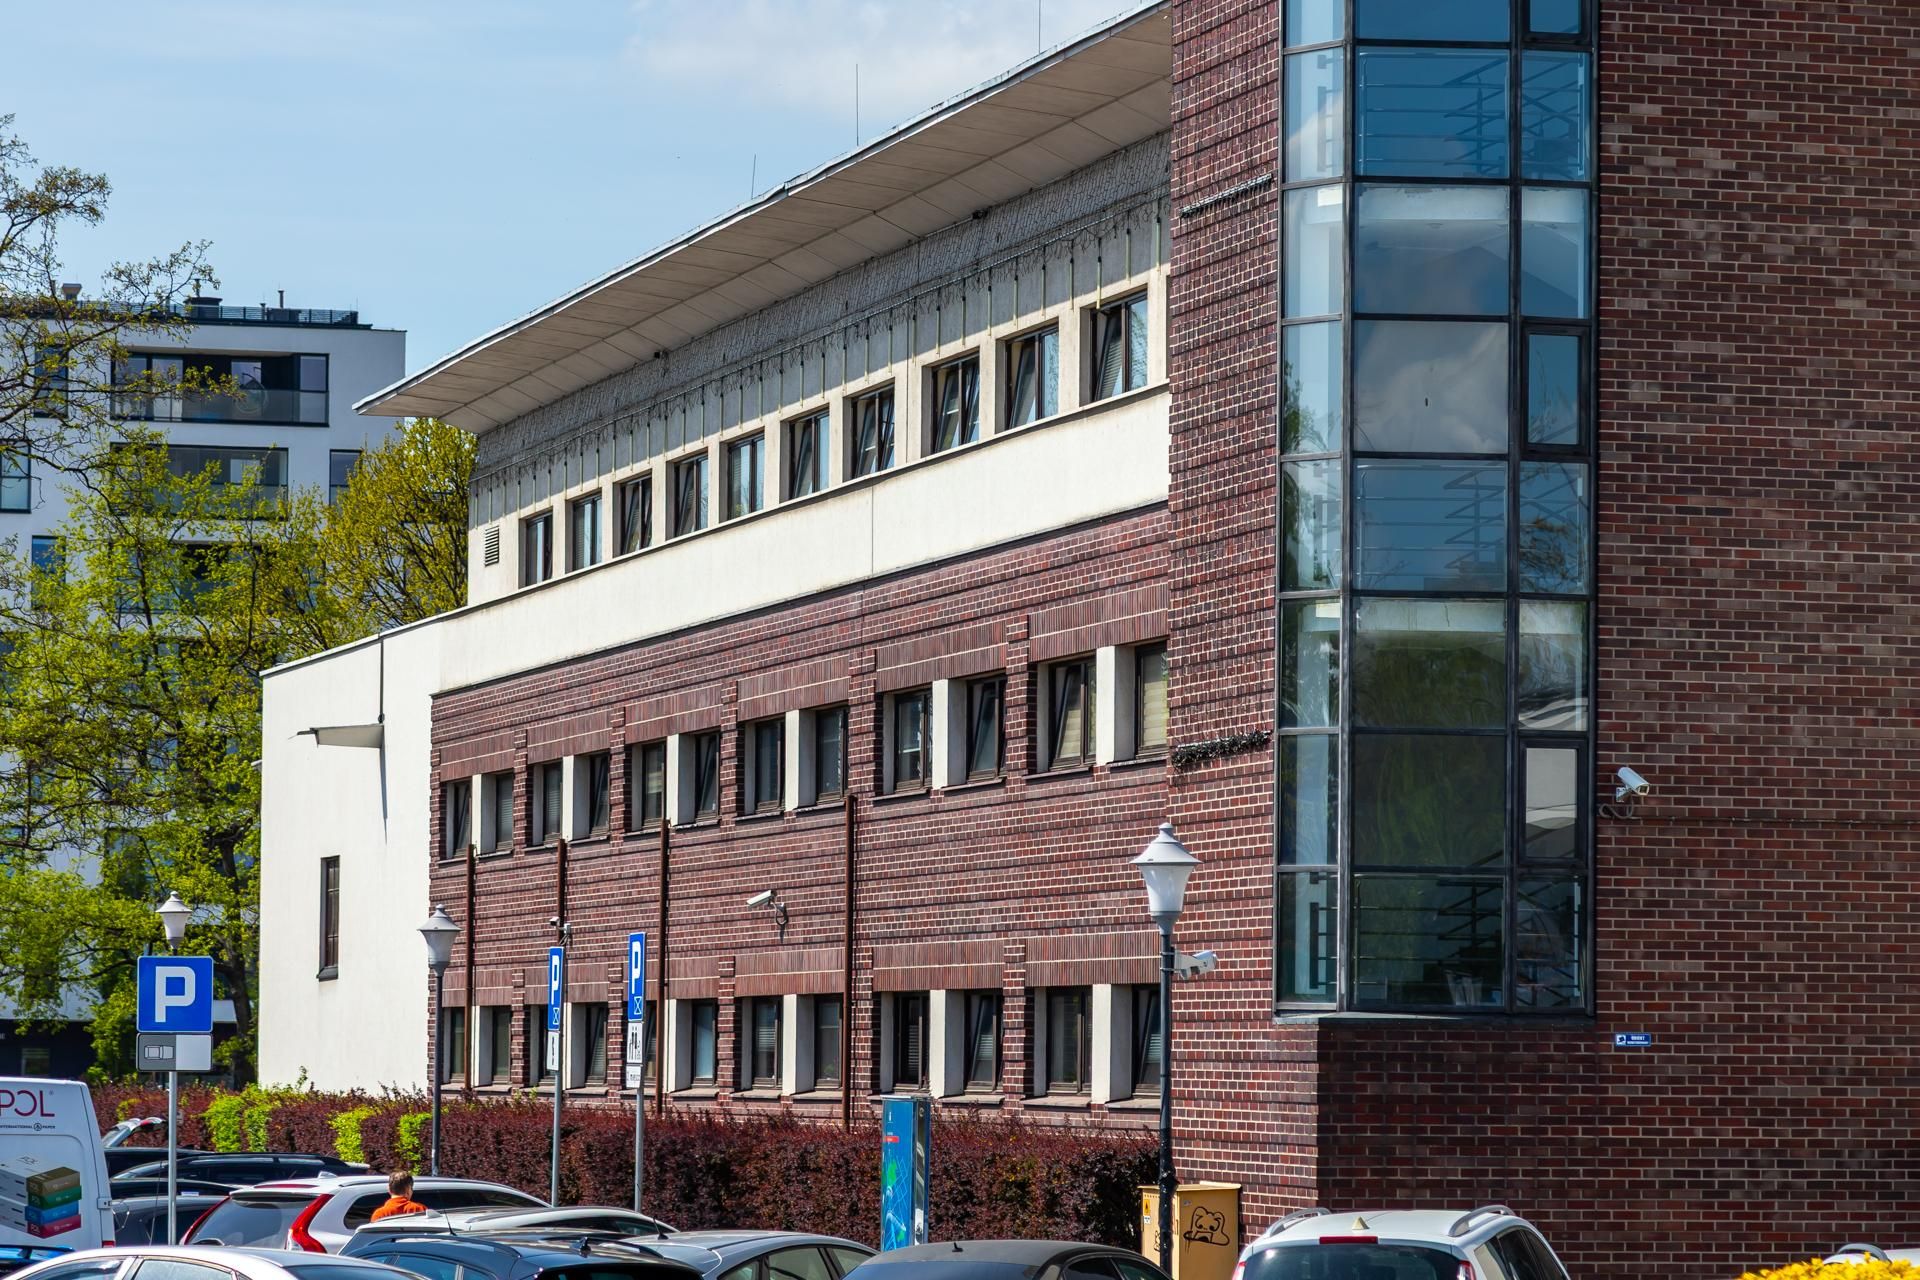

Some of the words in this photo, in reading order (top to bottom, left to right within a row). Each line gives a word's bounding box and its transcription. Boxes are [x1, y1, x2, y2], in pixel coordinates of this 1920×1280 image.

[155, 966, 196, 1022] P
[551, 955, 560, 1005] P
[632, 941, 641, 994] P
